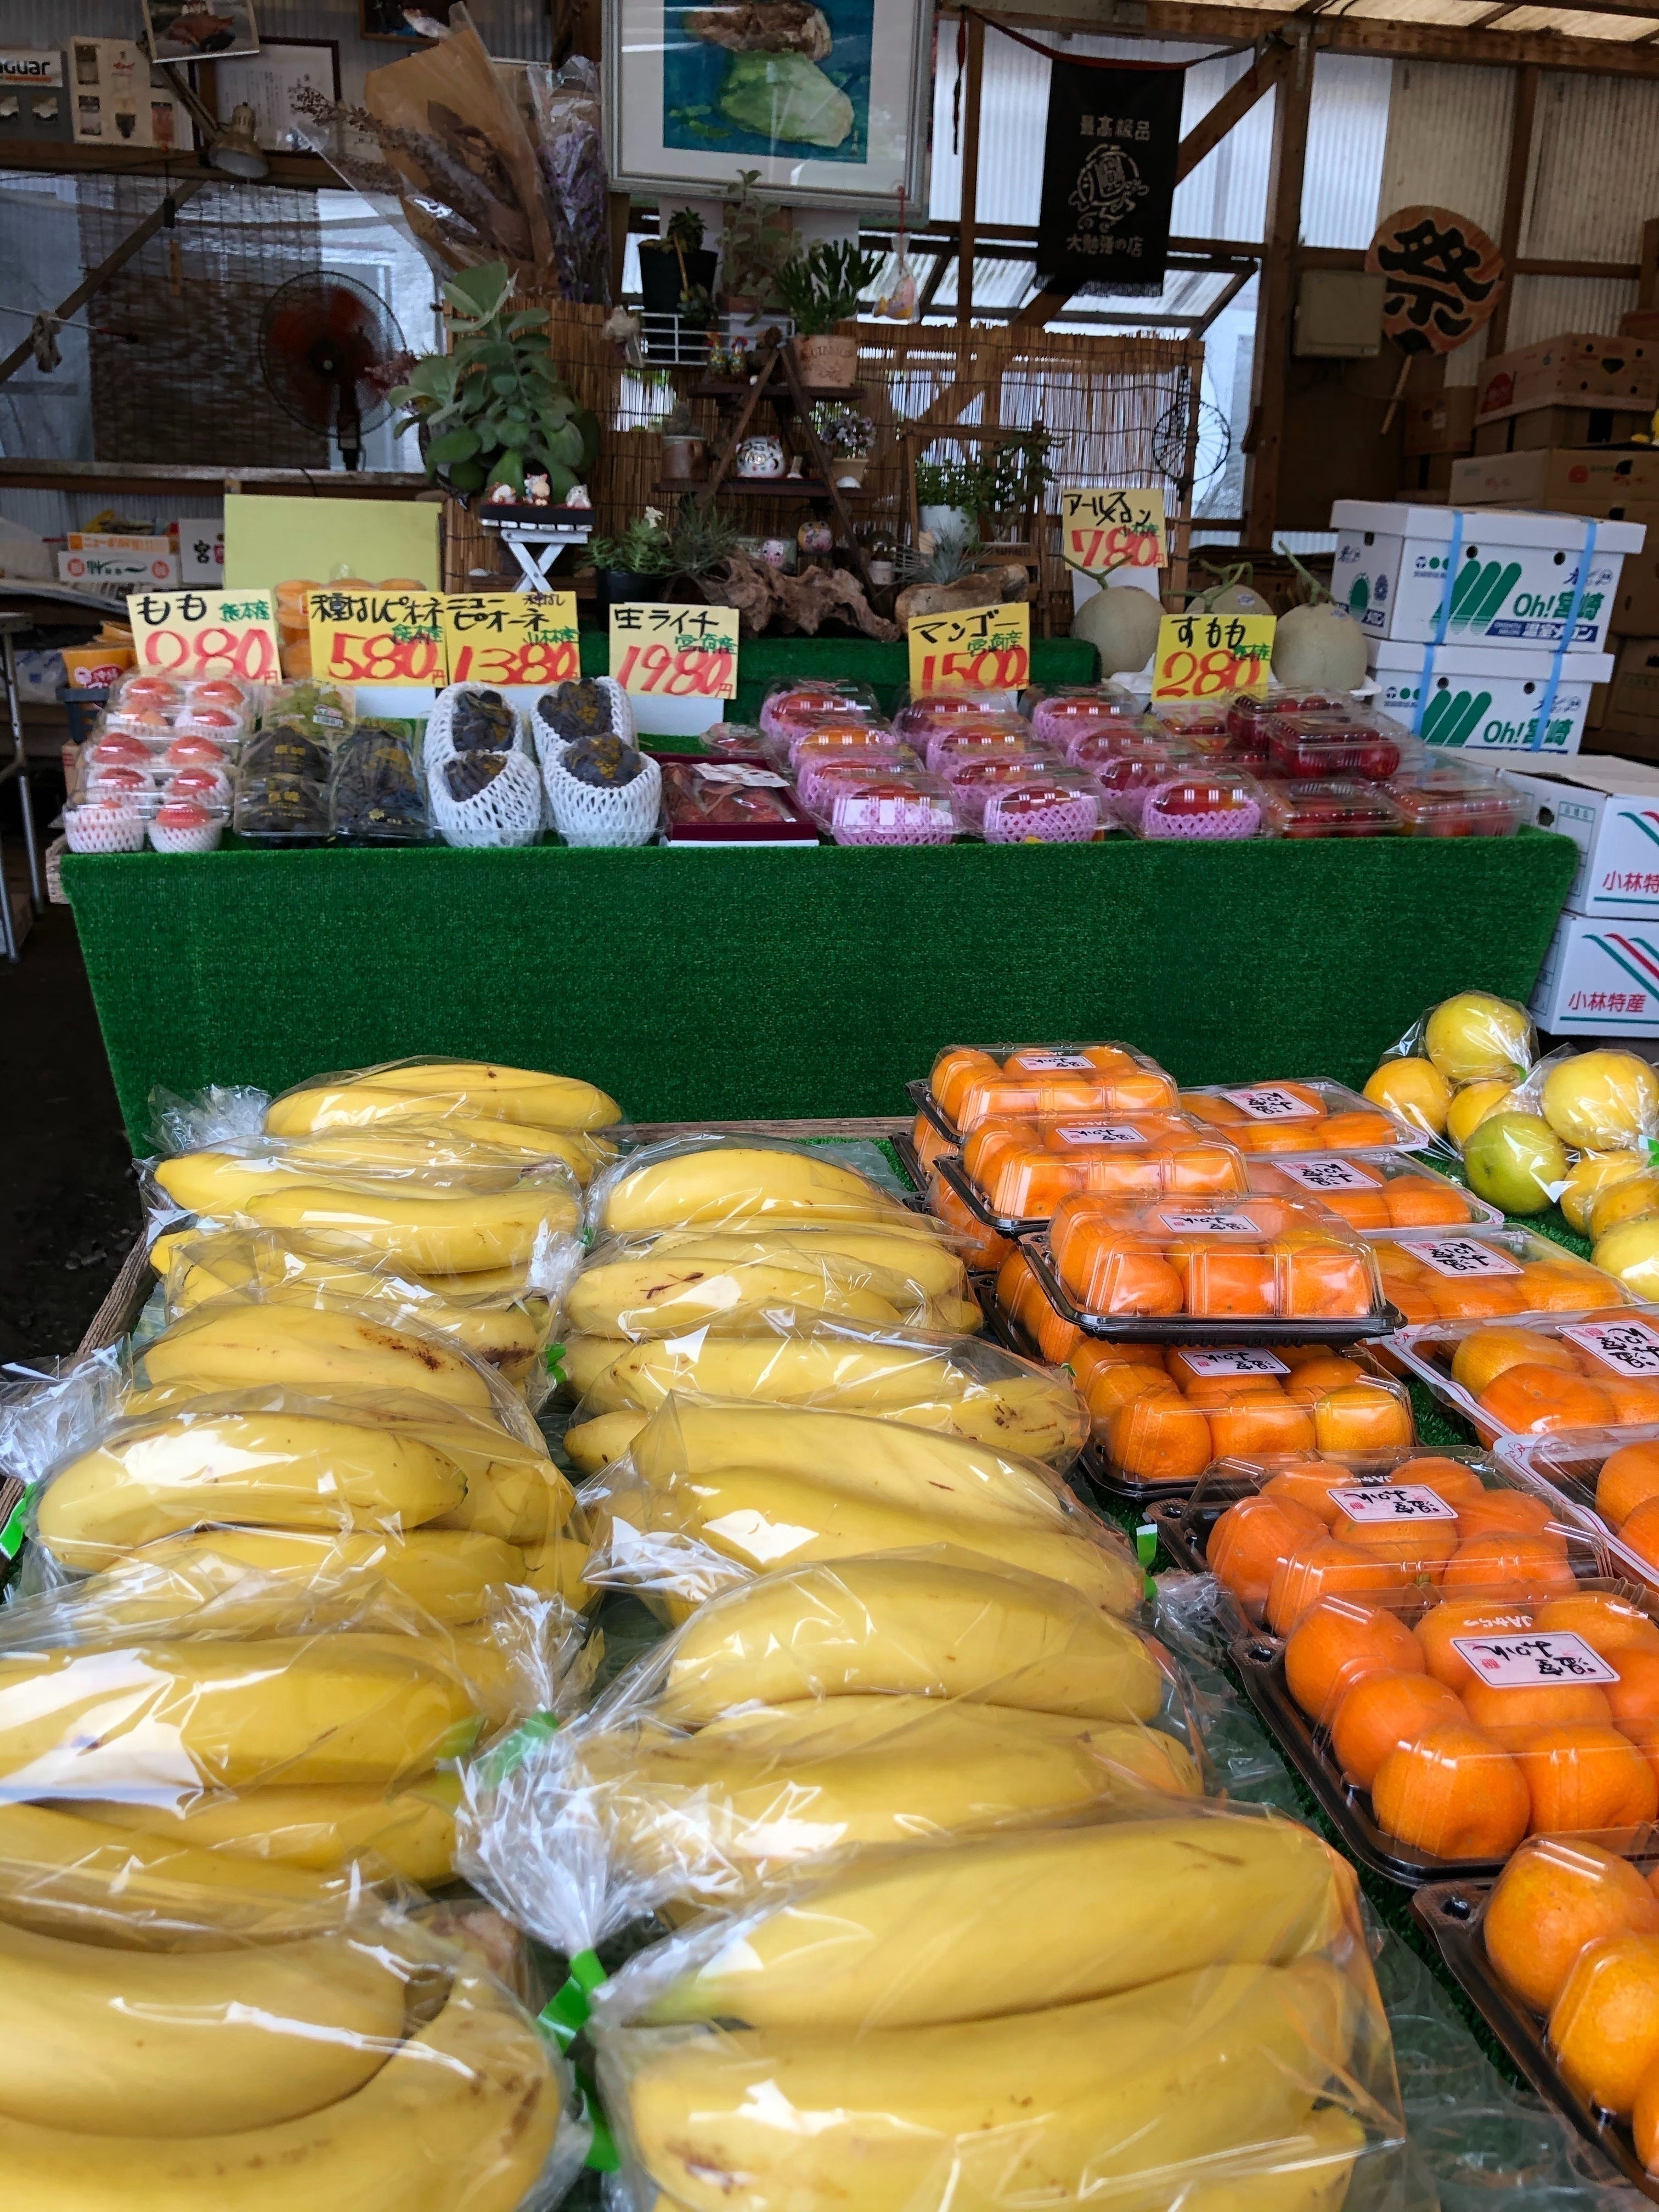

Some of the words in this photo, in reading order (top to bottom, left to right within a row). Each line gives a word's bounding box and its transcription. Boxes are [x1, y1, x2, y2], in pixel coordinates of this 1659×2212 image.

[1379, 219, 1496, 336] 祭
[136, 594, 207, 625] もも
[454, 608, 550, 632] ピオーネ
[614, 608, 719, 637] 生ライチ
[912, 608, 1020, 644] マンゴー
[1171, 616, 1246, 648] すもも
[1567, 991, 1646, 1014] 小林特産
